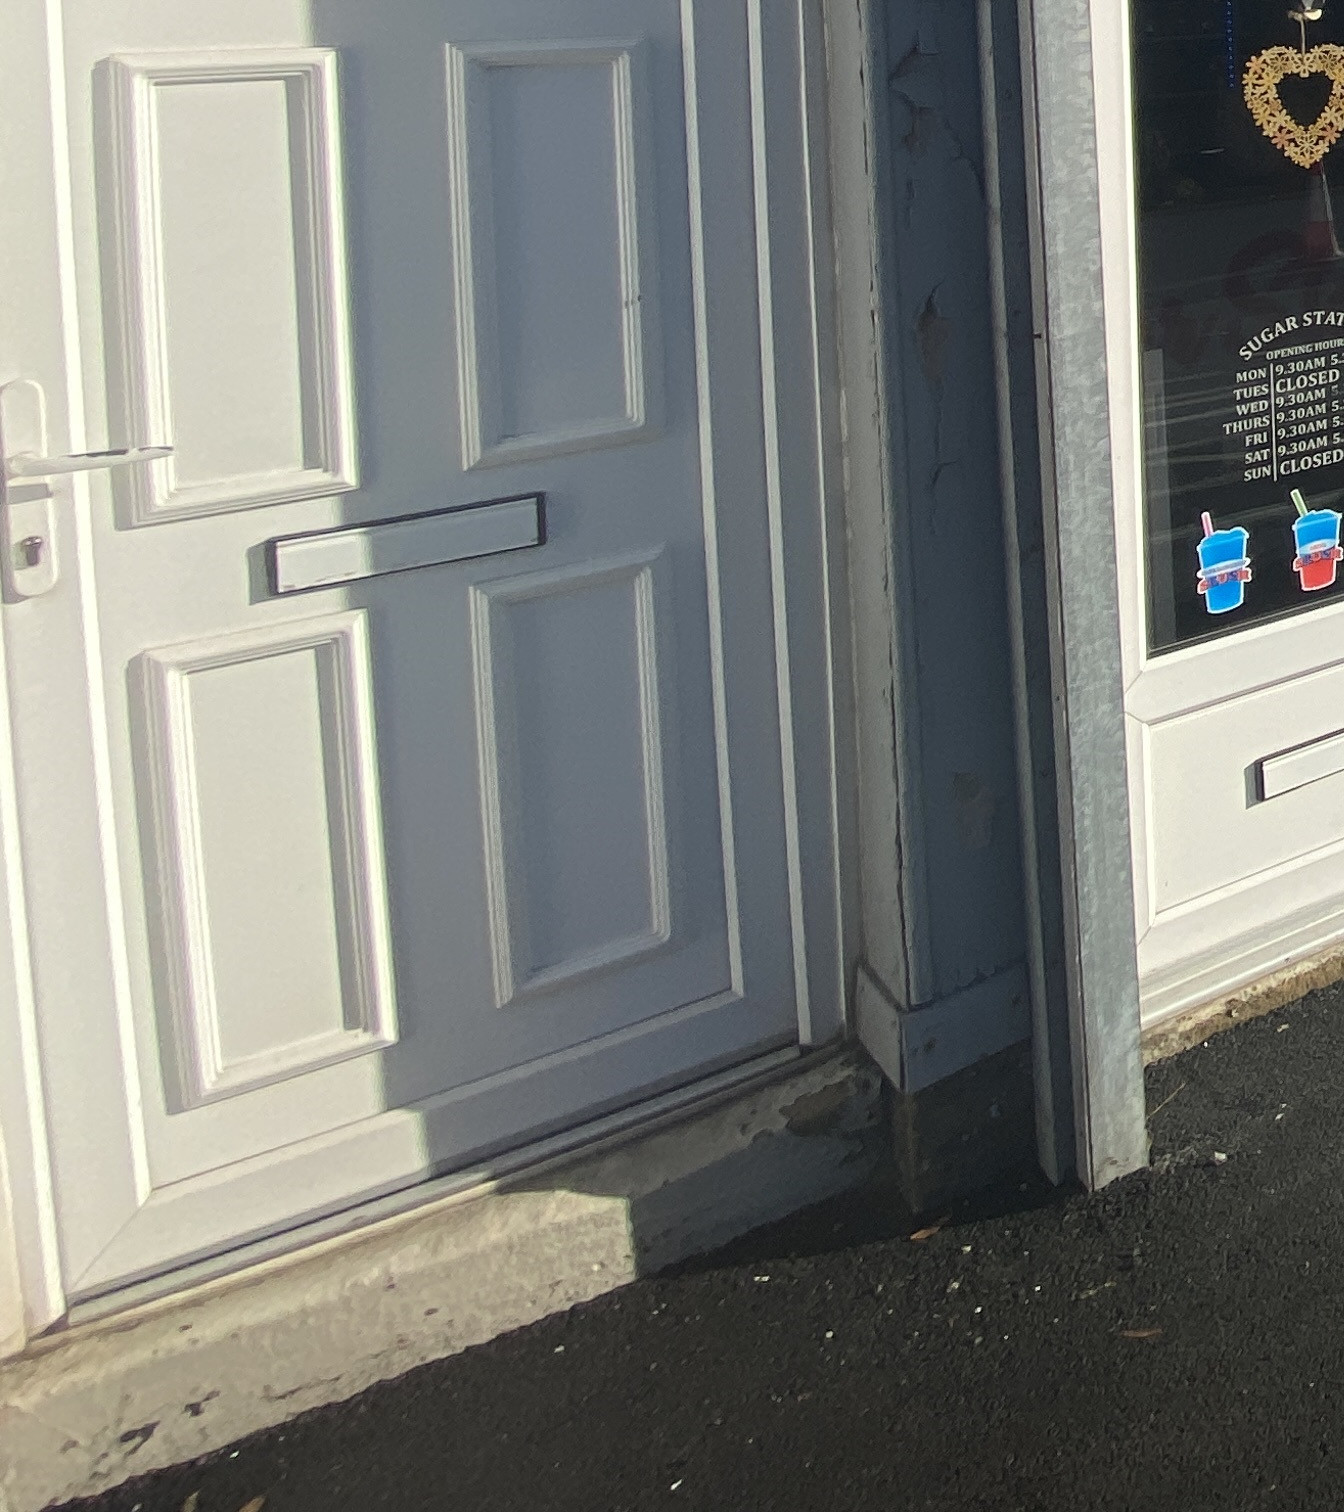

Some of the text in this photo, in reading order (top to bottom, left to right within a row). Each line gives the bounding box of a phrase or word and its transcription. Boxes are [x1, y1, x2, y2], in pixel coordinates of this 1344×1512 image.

[1238, 315, 1300, 362] SUGAR
[1265, 343, 1313, 361] OPENING
[1233, 368, 1341, 401] TUES CLOSED
[1236, 367, 1267, 383] MON
[1275, 356, 1326, 376] 9.30AM
[1236, 400, 1269, 416] WED
[1275, 388, 1326, 408] 9.30AM
[1223, 414, 1270, 435] THURS
[1276, 402, 1327, 424] 9.30AM
[1245, 431, 1268, 447] FRI
[1277, 418, 1328, 440] 9.30AM
[1243, 448, 1344, 482] SUN CLOSED
[1245, 448, 1271, 465] SAT
[1277, 435, 1328, 457] 9.30AM
